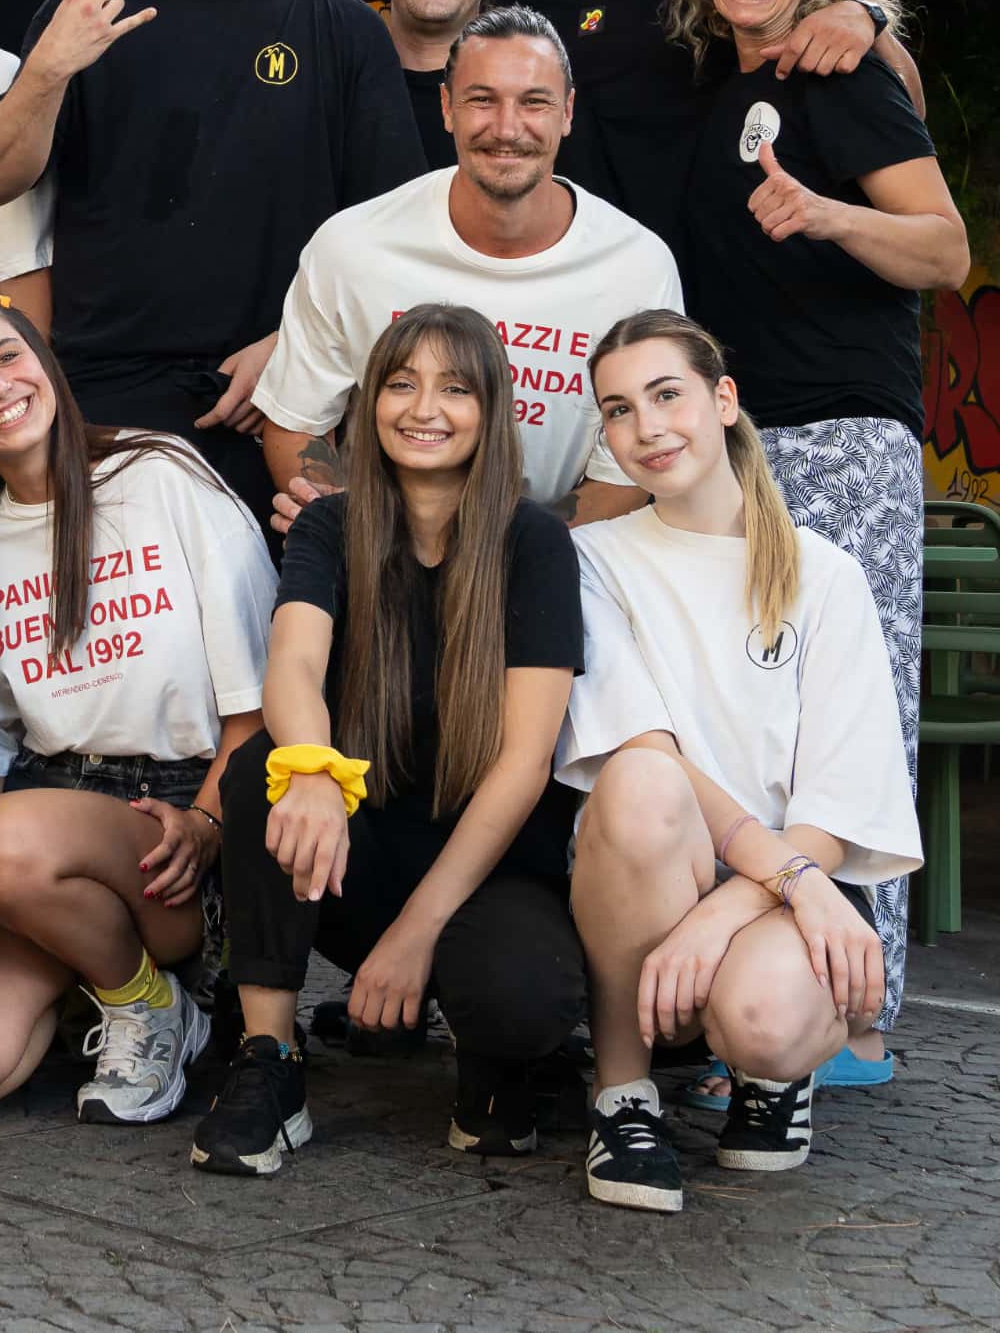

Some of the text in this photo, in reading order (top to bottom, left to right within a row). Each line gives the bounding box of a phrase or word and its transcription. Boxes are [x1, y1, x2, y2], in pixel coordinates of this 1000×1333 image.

[569, 332, 590, 358] E
[142, 544, 163, 572] E
[90, 587, 174, 626] ONDA
[21, 631, 144, 684] DAL 1992
